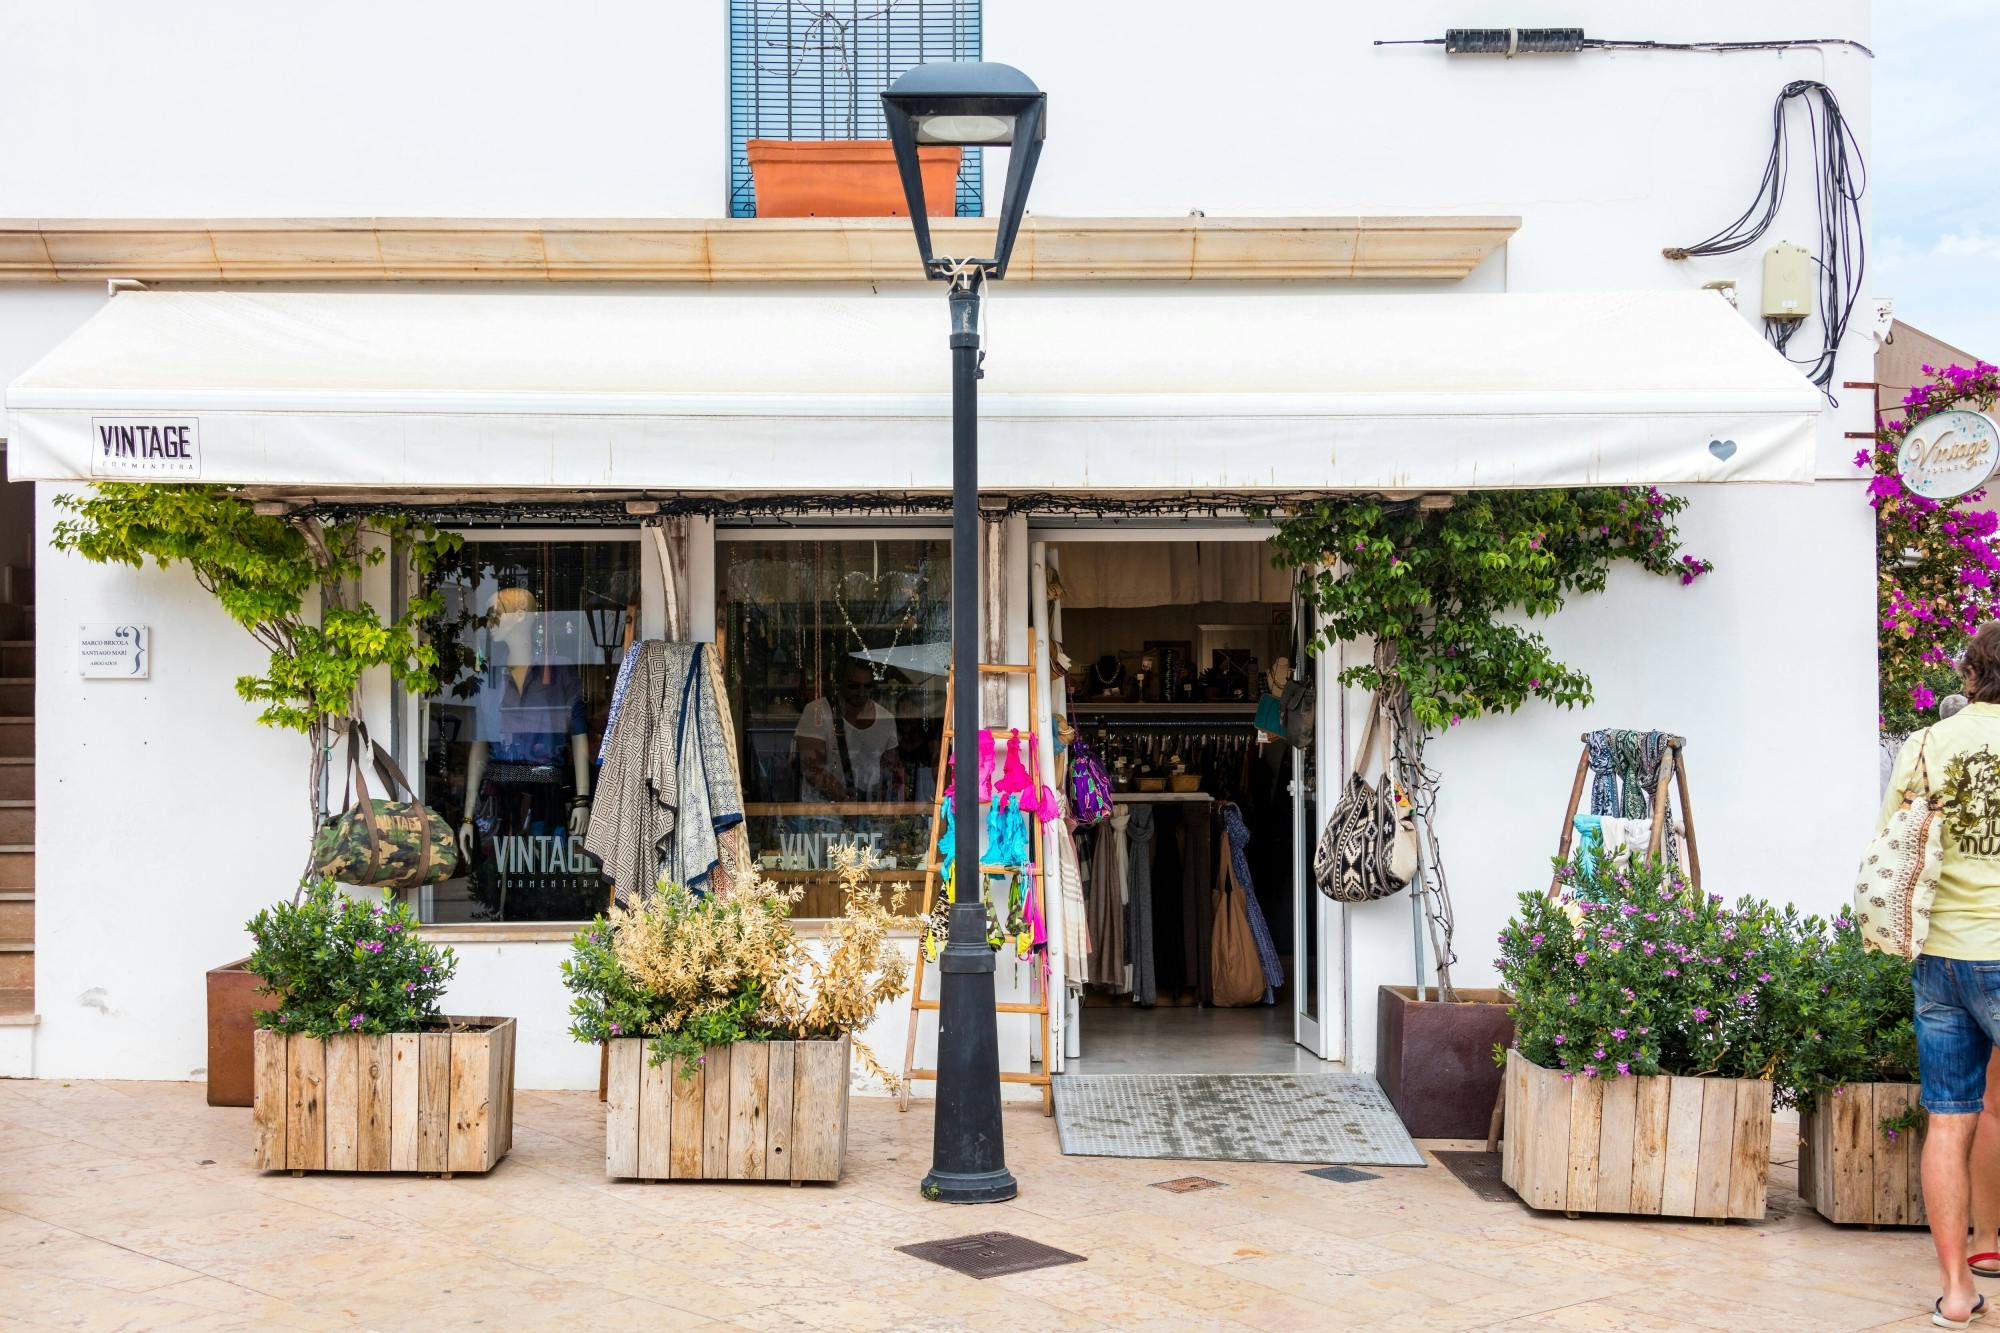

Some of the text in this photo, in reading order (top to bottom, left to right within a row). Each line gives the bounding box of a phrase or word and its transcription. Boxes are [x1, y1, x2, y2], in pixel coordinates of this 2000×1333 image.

[100, 425, 192, 459] VINTAGE
[1908, 431, 1990, 470] Vintage
[102, 461, 193, 470] FORMENTERA
[497, 880, 599, 888] FORMENTERA
